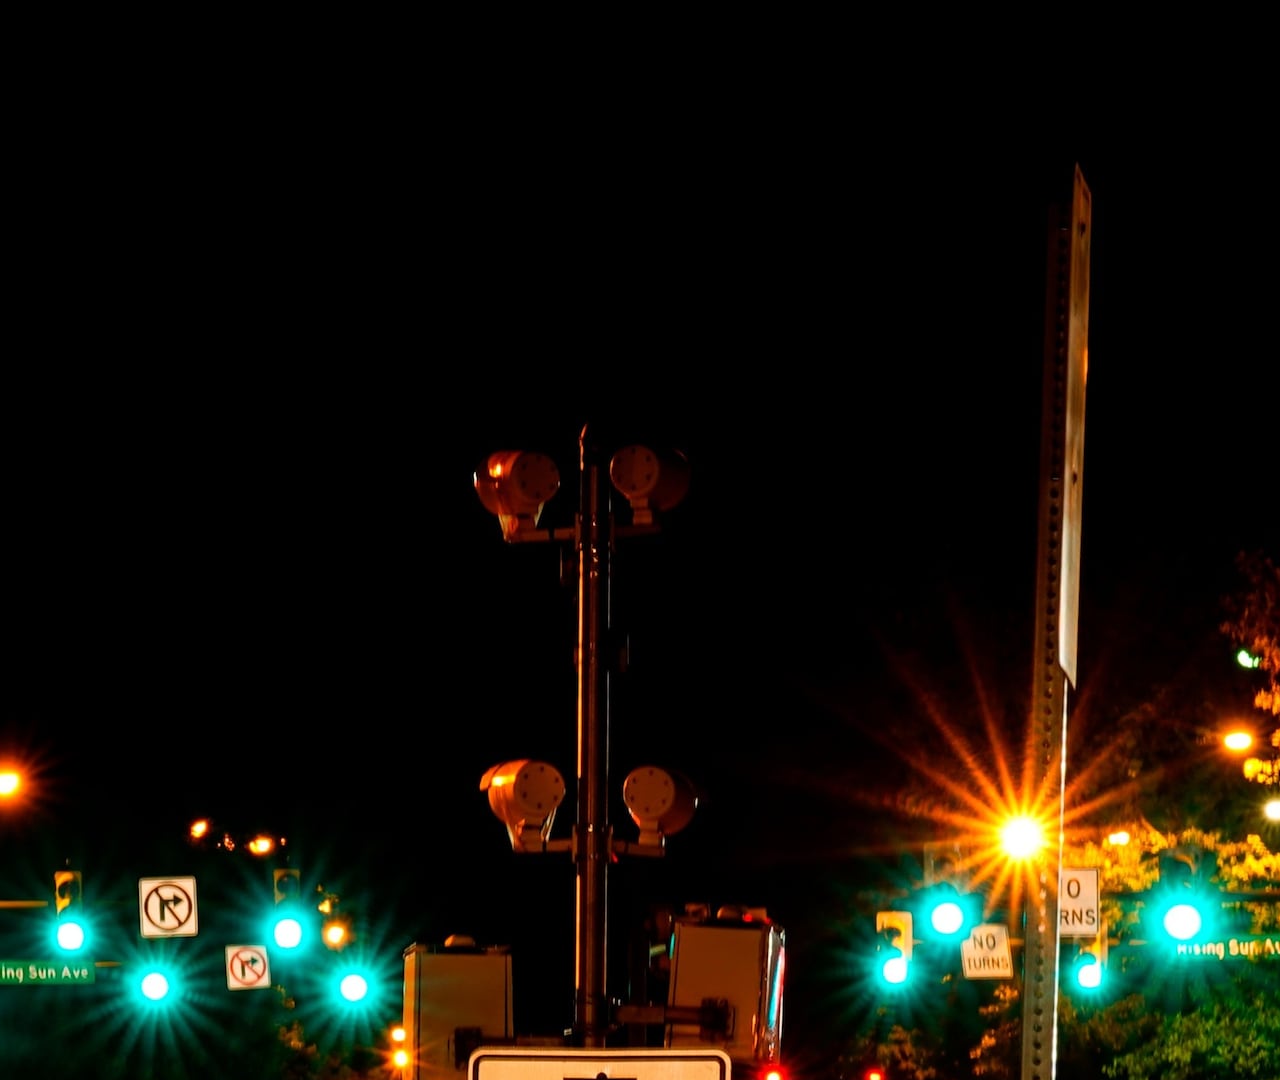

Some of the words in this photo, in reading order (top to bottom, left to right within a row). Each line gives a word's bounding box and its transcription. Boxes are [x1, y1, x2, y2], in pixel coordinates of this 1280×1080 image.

[1061, 879, 1081, 898] O
[1061, 909, 1096, 925] RNS
[972, 933, 996, 950] NO
[1229, 938, 1256, 956] Sun
[966, 955, 1009, 971] TURNS
[28, 965, 56, 980] Sun
[61, 965, 89, 980] Ave
